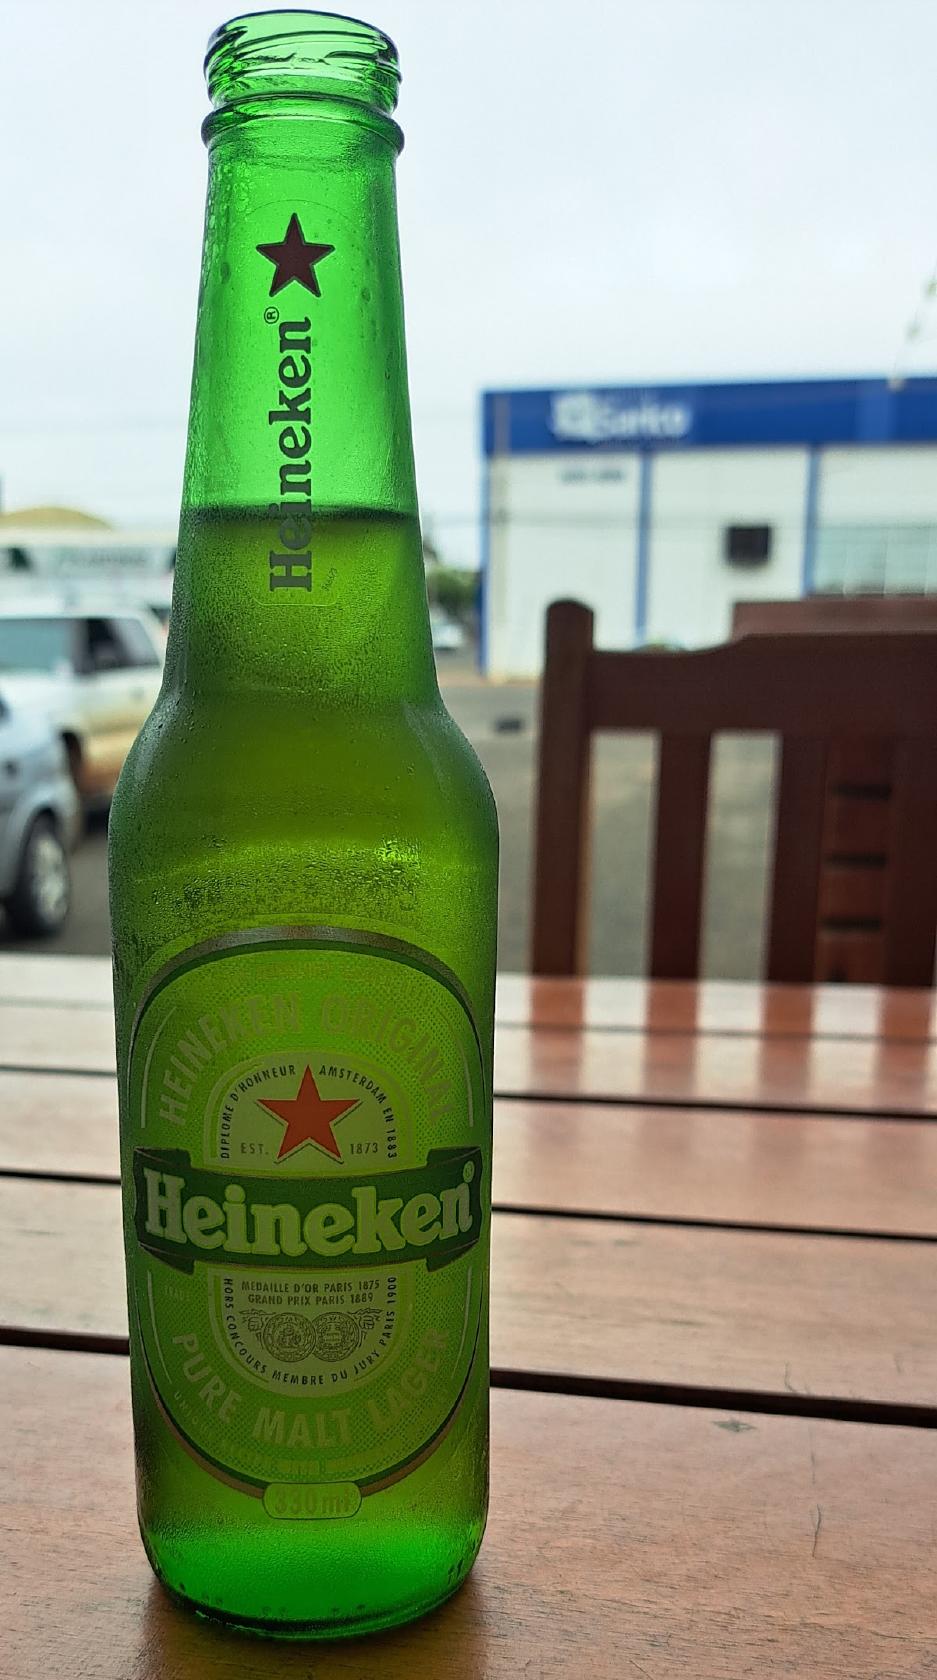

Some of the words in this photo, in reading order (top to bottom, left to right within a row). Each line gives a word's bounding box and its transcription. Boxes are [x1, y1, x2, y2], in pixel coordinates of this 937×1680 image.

[159, 993, 300, 1126] HEINEKEN
[229, 1064, 297, 1103] D'HONNEUR
[319, 1064, 388, 1104] AMSTERDAM
[382, 1106, 395, 1123] EN
[220, 1104, 235, 1160] DIPLOME
[385, 1128, 398, 1160] 1883
[240, 1142, 269, 1156] EST.
[350, 1142, 379, 1155] 1873
[223, 1277, 234, 1309] HORS
[241, 1280, 289, 1293] MEDAILLE
[293, 1283, 319, 1294] D'OR
[324, 1281, 353, 1293] PARIS
[358, 1279, 380, 1291] 1875
[247, 1294, 283, 1305] GRAND
[287, 1295, 311, 1306] PRIX
[316, 1294, 345, 1305] PARIS
[350, 1292, 374, 1304] 1889
[386, 1276, 398, 1305] 1900
[226, 1315, 268, 1374] CONCOURS
[378, 1311, 396, 1347] PARIS
[271, 1370, 324, 1386] MEMBRE
[331, 1369, 348, 1383] DU
[353, 1350, 380, 1375] JURY
[172, 1332, 241, 1424] PURE
[252, 1406, 351, 1448] MALT
[364, 1327, 449, 1436] LAGER
